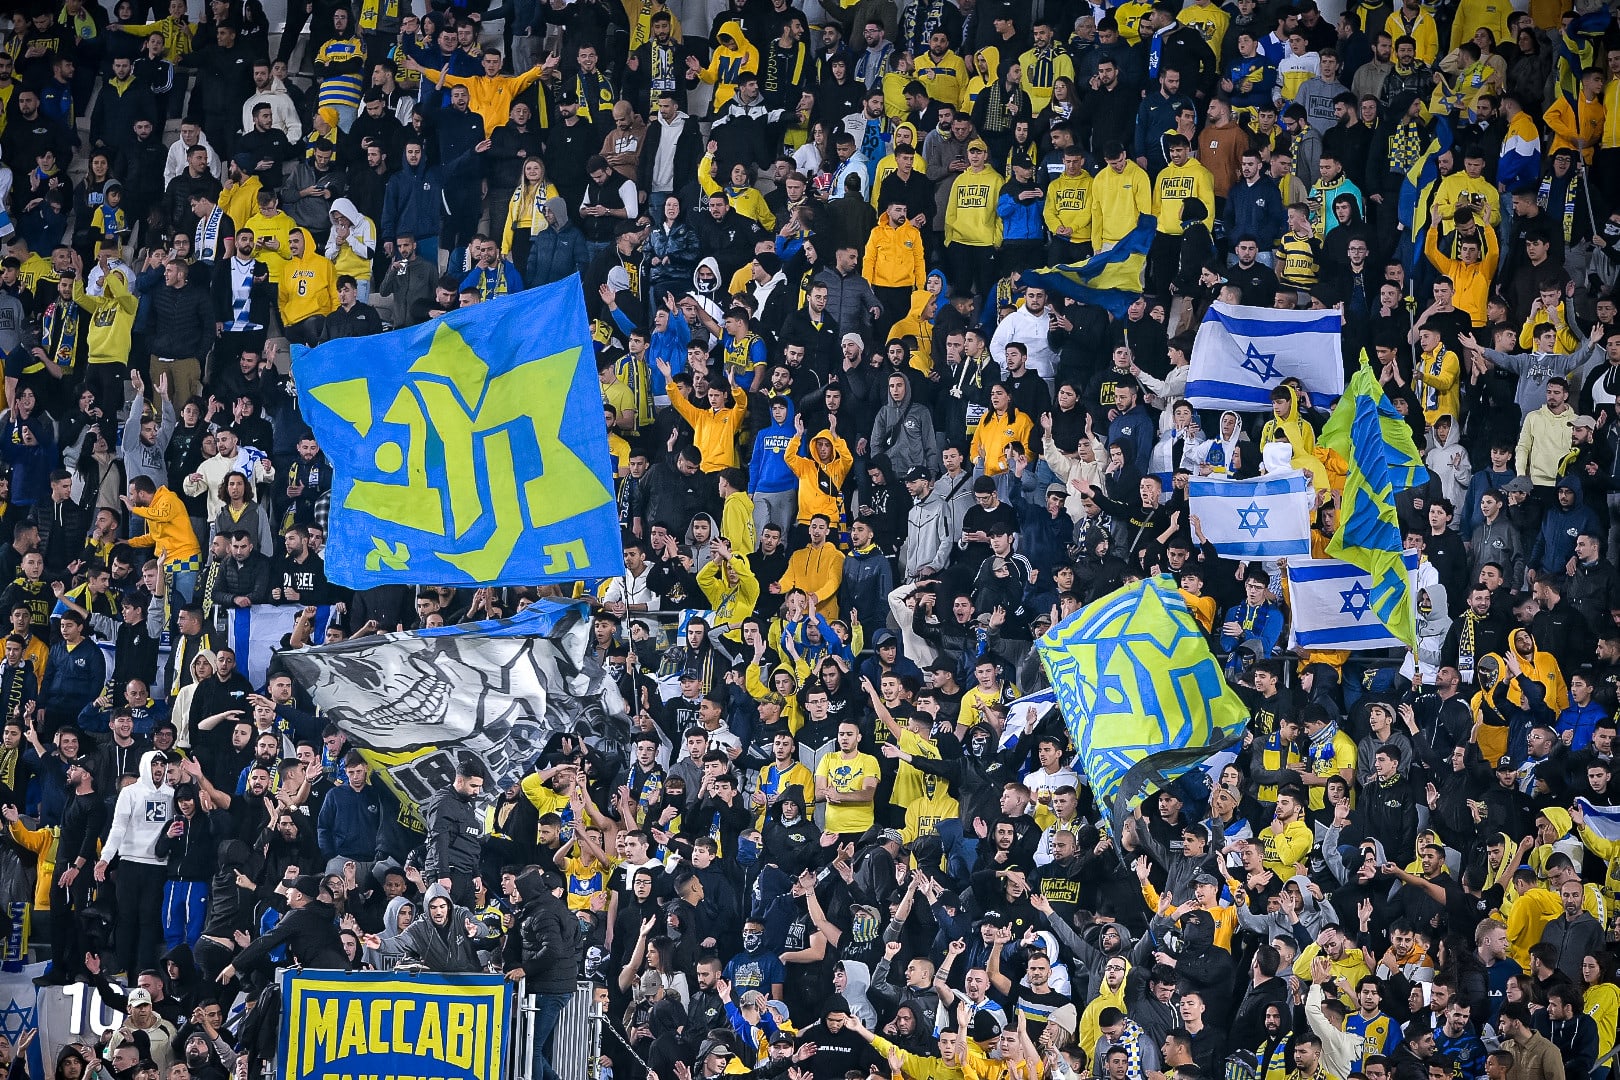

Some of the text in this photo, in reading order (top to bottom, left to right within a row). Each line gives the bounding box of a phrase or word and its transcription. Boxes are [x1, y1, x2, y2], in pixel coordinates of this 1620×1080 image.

[298, 279, 307, 297] 6
[765, 438, 790, 448] MACCAB
[1042, 879, 1078, 893] MACCABI
[1044, 890, 1072, 901] FANATICS
[302, 997, 488, 1080] MACCABI
